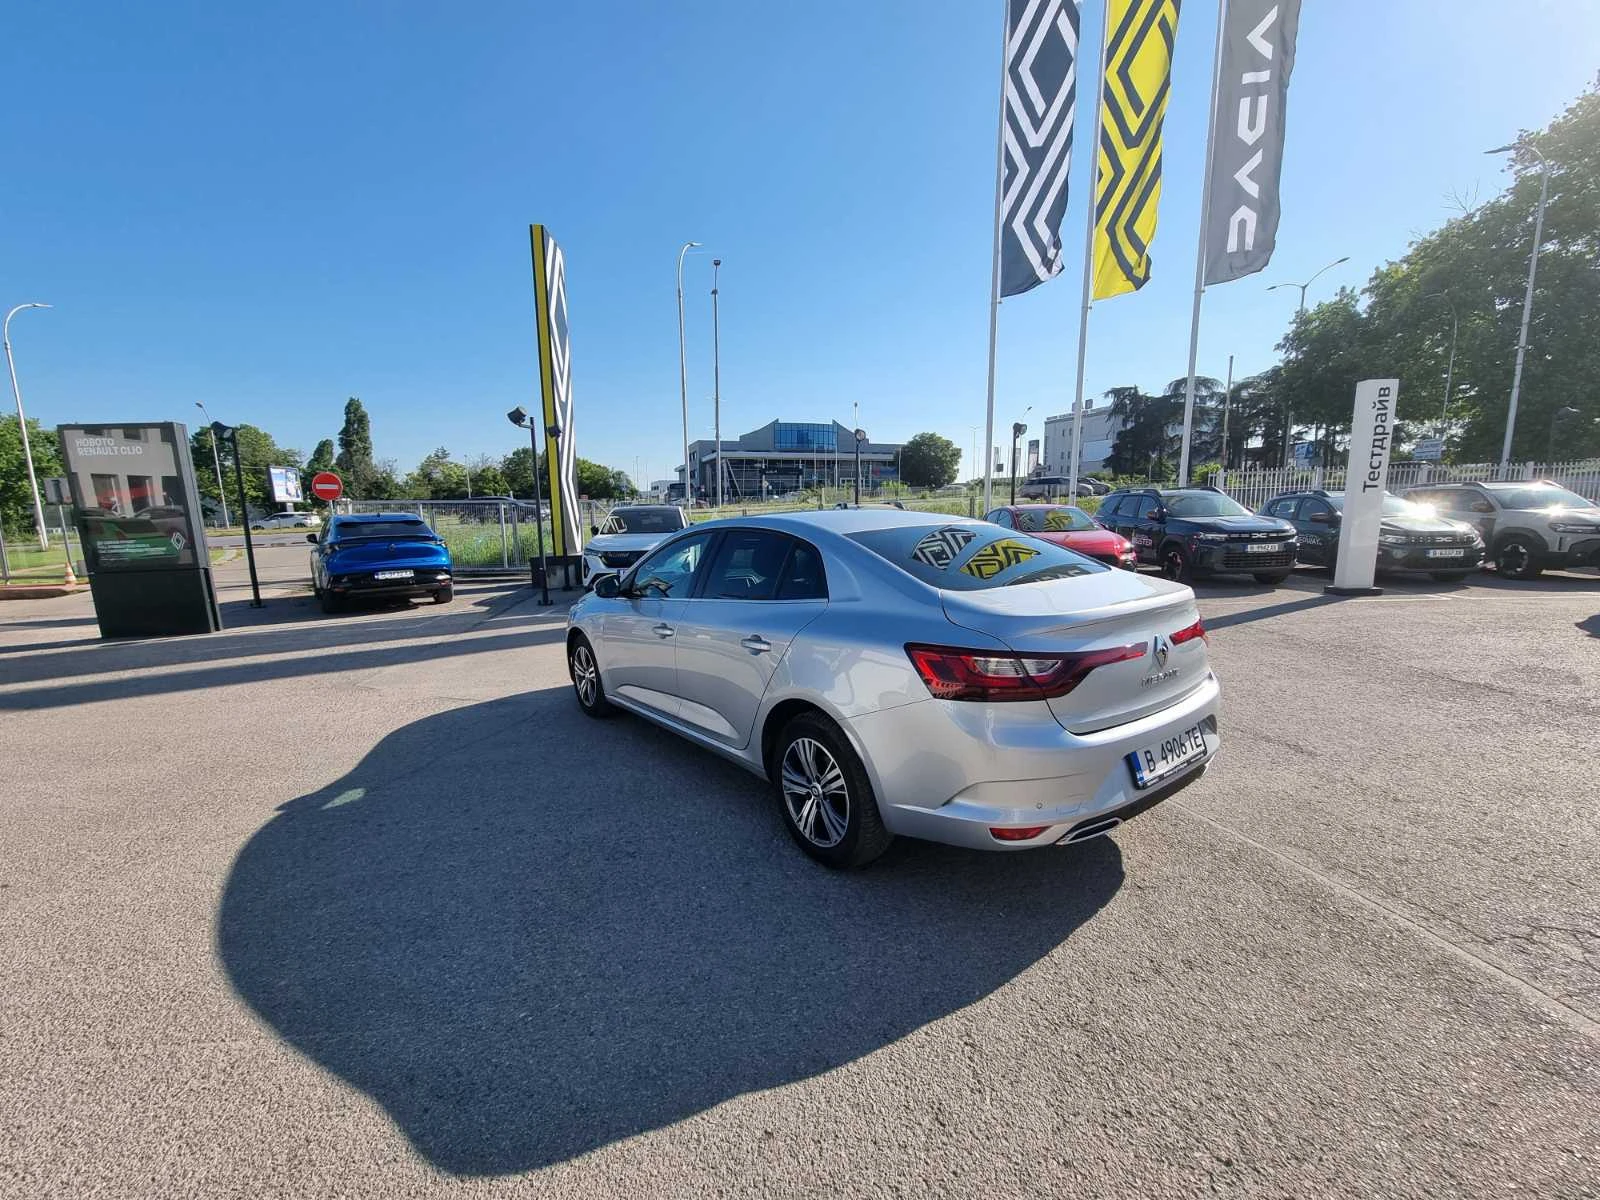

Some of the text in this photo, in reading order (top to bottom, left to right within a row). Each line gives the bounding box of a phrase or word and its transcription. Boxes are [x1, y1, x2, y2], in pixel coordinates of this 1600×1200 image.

[1226, 5, 1278, 253] DACIA
[77, 446, 143, 456] RENAULT CLIO
[1363, 386, 1391, 493] Тестдрайв
[1144, 750, 1156, 773] B
[1161, 734, 1188, 764] 4906
[1185, 727, 1203, 751] TE
